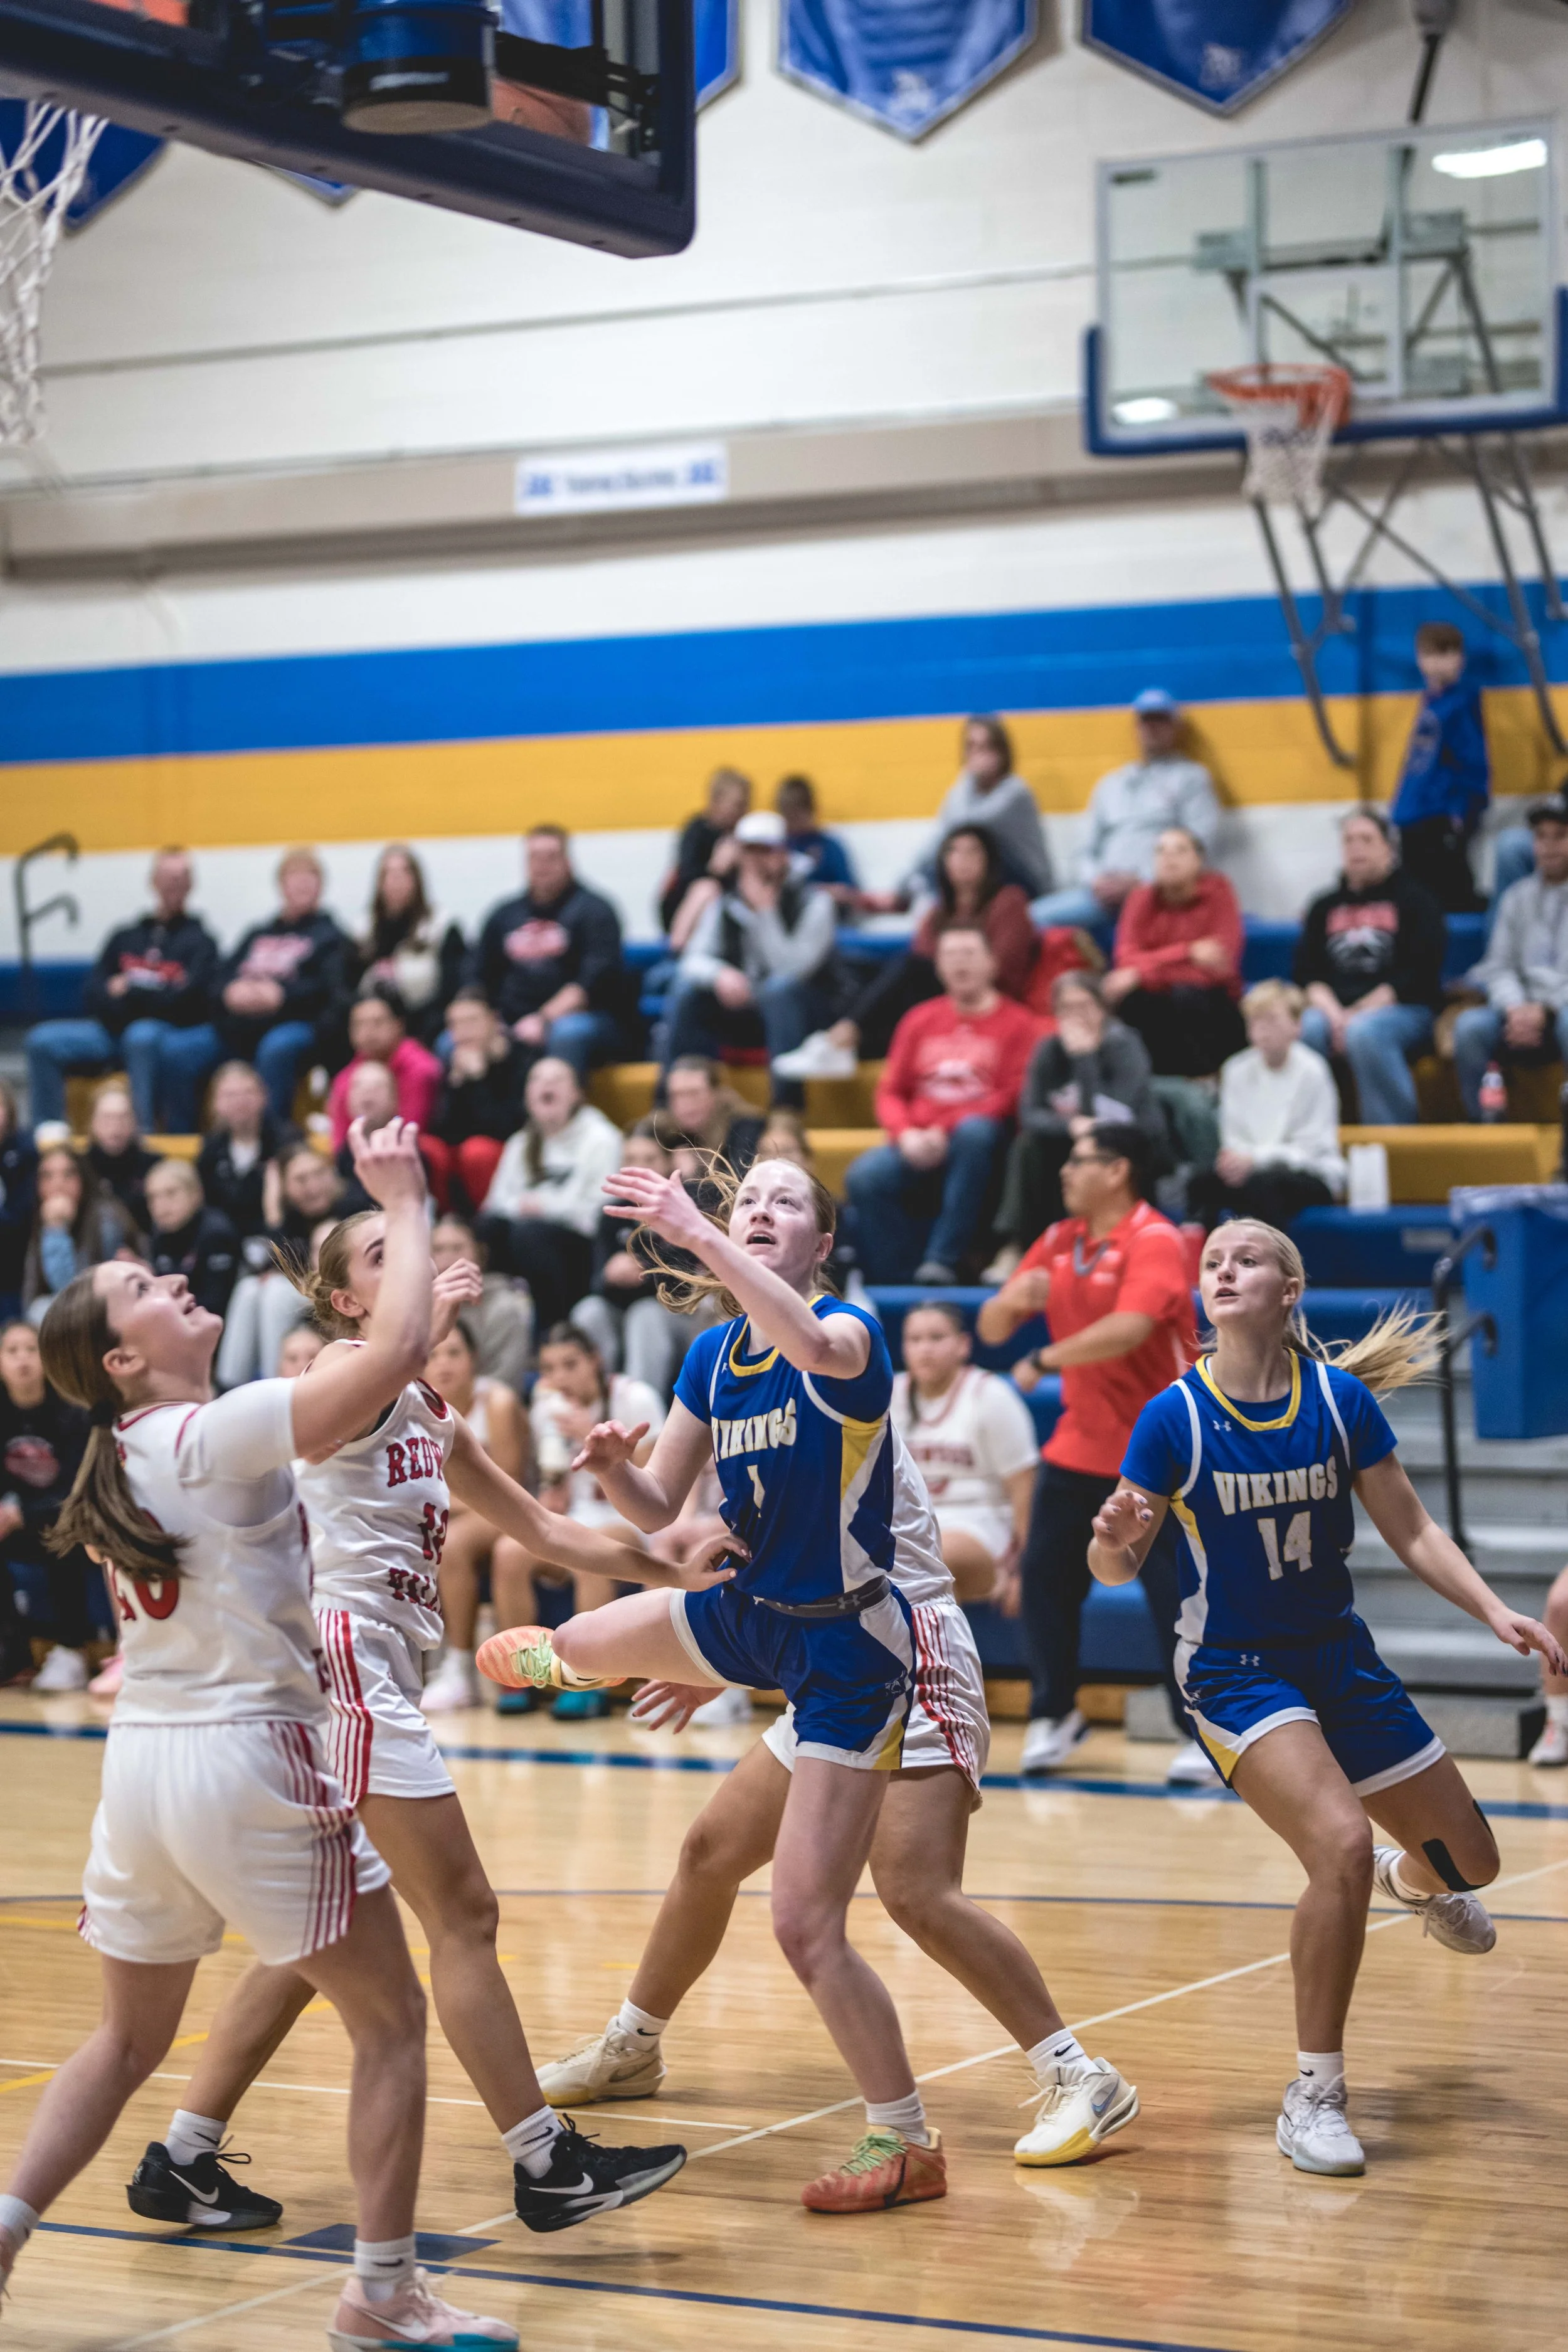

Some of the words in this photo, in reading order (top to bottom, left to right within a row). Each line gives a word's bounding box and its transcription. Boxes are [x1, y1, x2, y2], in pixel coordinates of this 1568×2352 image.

[746, 1464, 766, 1518] 1
[1212, 1455, 1338, 1516] VIKINGS
[1257, 1510, 1313, 1581] 14
